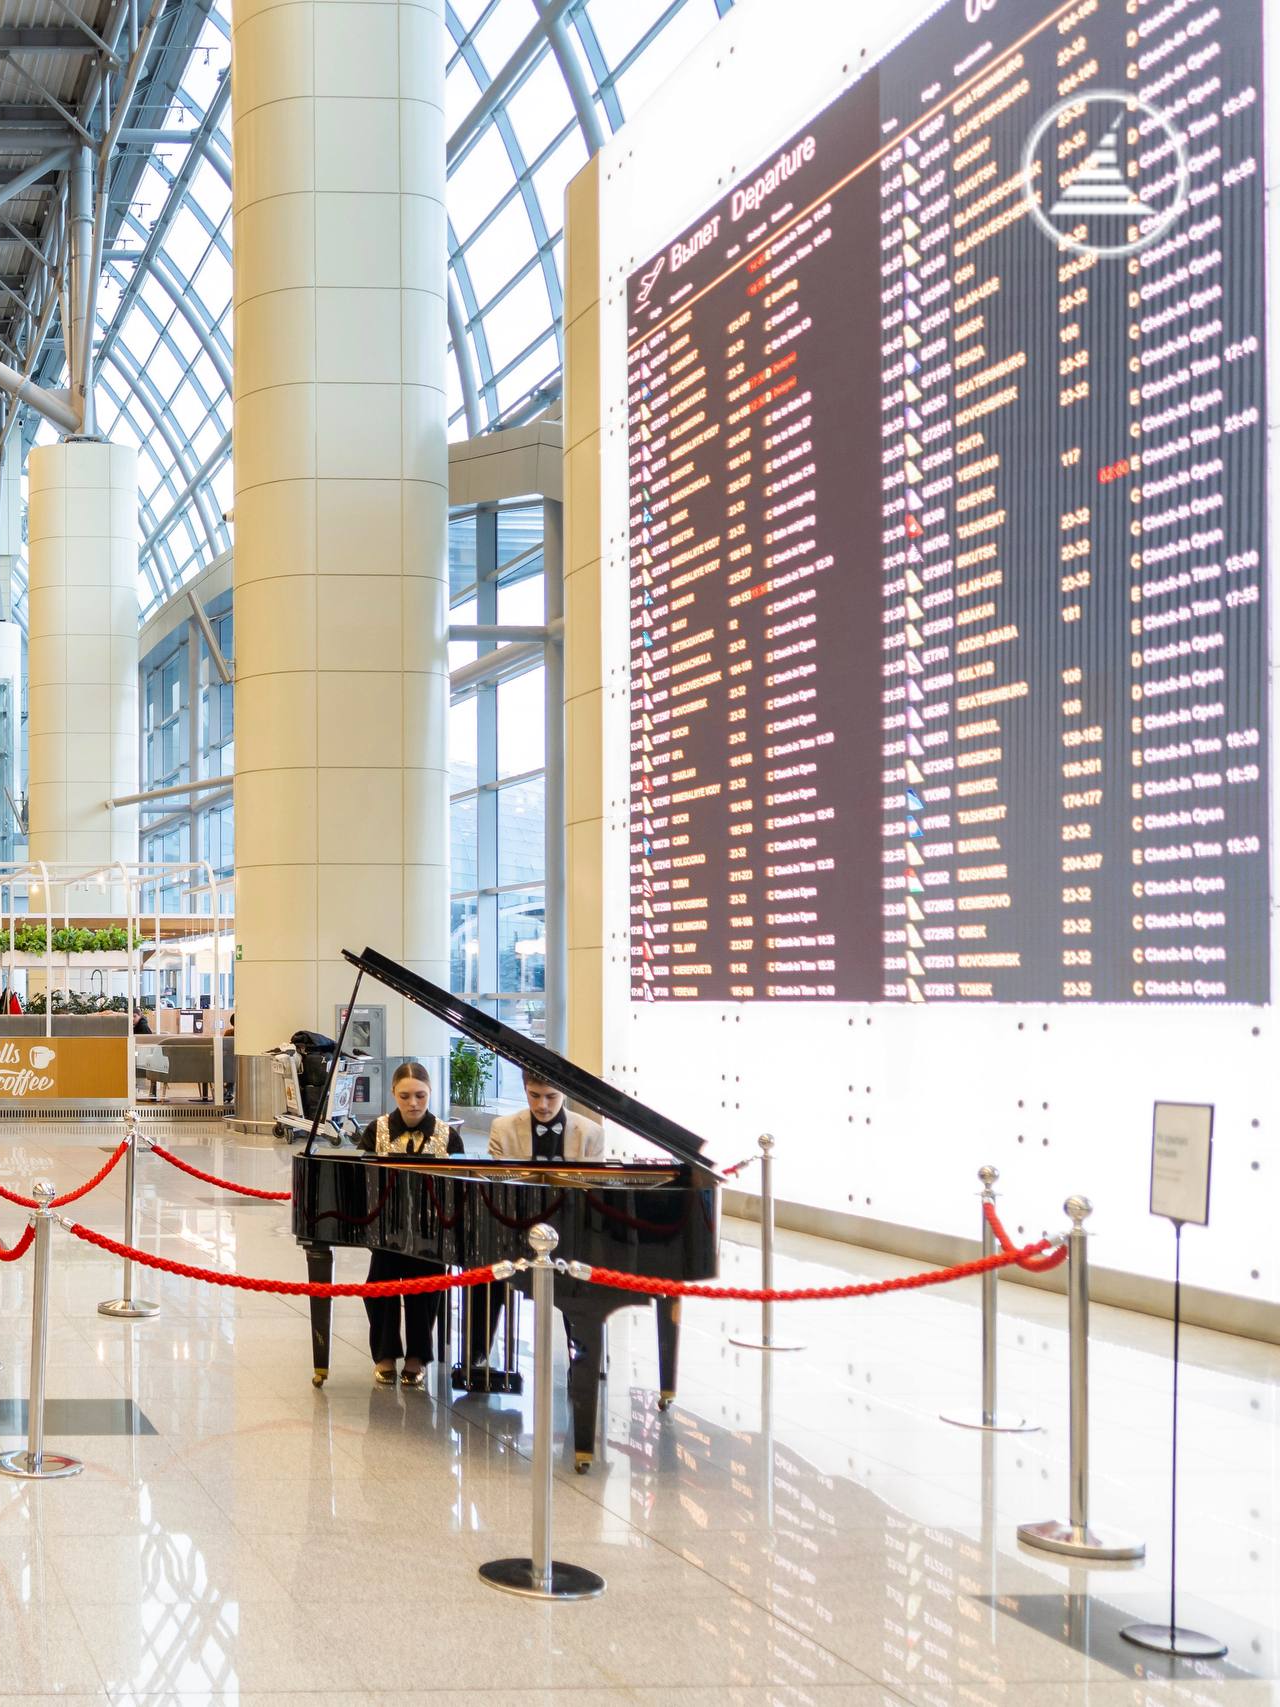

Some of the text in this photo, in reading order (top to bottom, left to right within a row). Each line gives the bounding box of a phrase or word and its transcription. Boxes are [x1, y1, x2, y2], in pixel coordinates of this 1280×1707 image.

[1127, 8, 1219, 78] C Check-in Open
[671, 136, 816, 273] Вылет Departure
[1129, 216, 1220, 274] C Check-in Open
[1130, 390, 1139, 404] E
[1142, 370, 1188, 398] Check-in
[1191, 356, 1219, 376] Time
[1128, 455, 1139, 471] E
[1142, 437, 1189, 464] Check-in
[1191, 426, 1219, 444] Time
[1131, 494, 1222, 535] C Check-in Open
[1132, 586, 1140, 601] E
[1143, 574, 1190, 596] Check-in
[1192, 565, 1220, 581] Time
[1132, 619, 1140, 634] E
[1143, 608, 1190, 630] Check-in
[1192, 600, 1220, 616] Time
[1132, 669, 1223, 700] D Check-in Open
[1133, 751, 1141, 765] E
[1144, 743, 1191, 762] Check-in
[1192, 739, 1221, 753] Time
[1133, 849, 1141, 864] E
[1144, 845, 1191, 862] Check-in
[1193, 842, 1221, 856] Time
[1133, 912, 1224, 929] C Check-in Open
[1133, 980, 1225, 997] C Check-in Open
